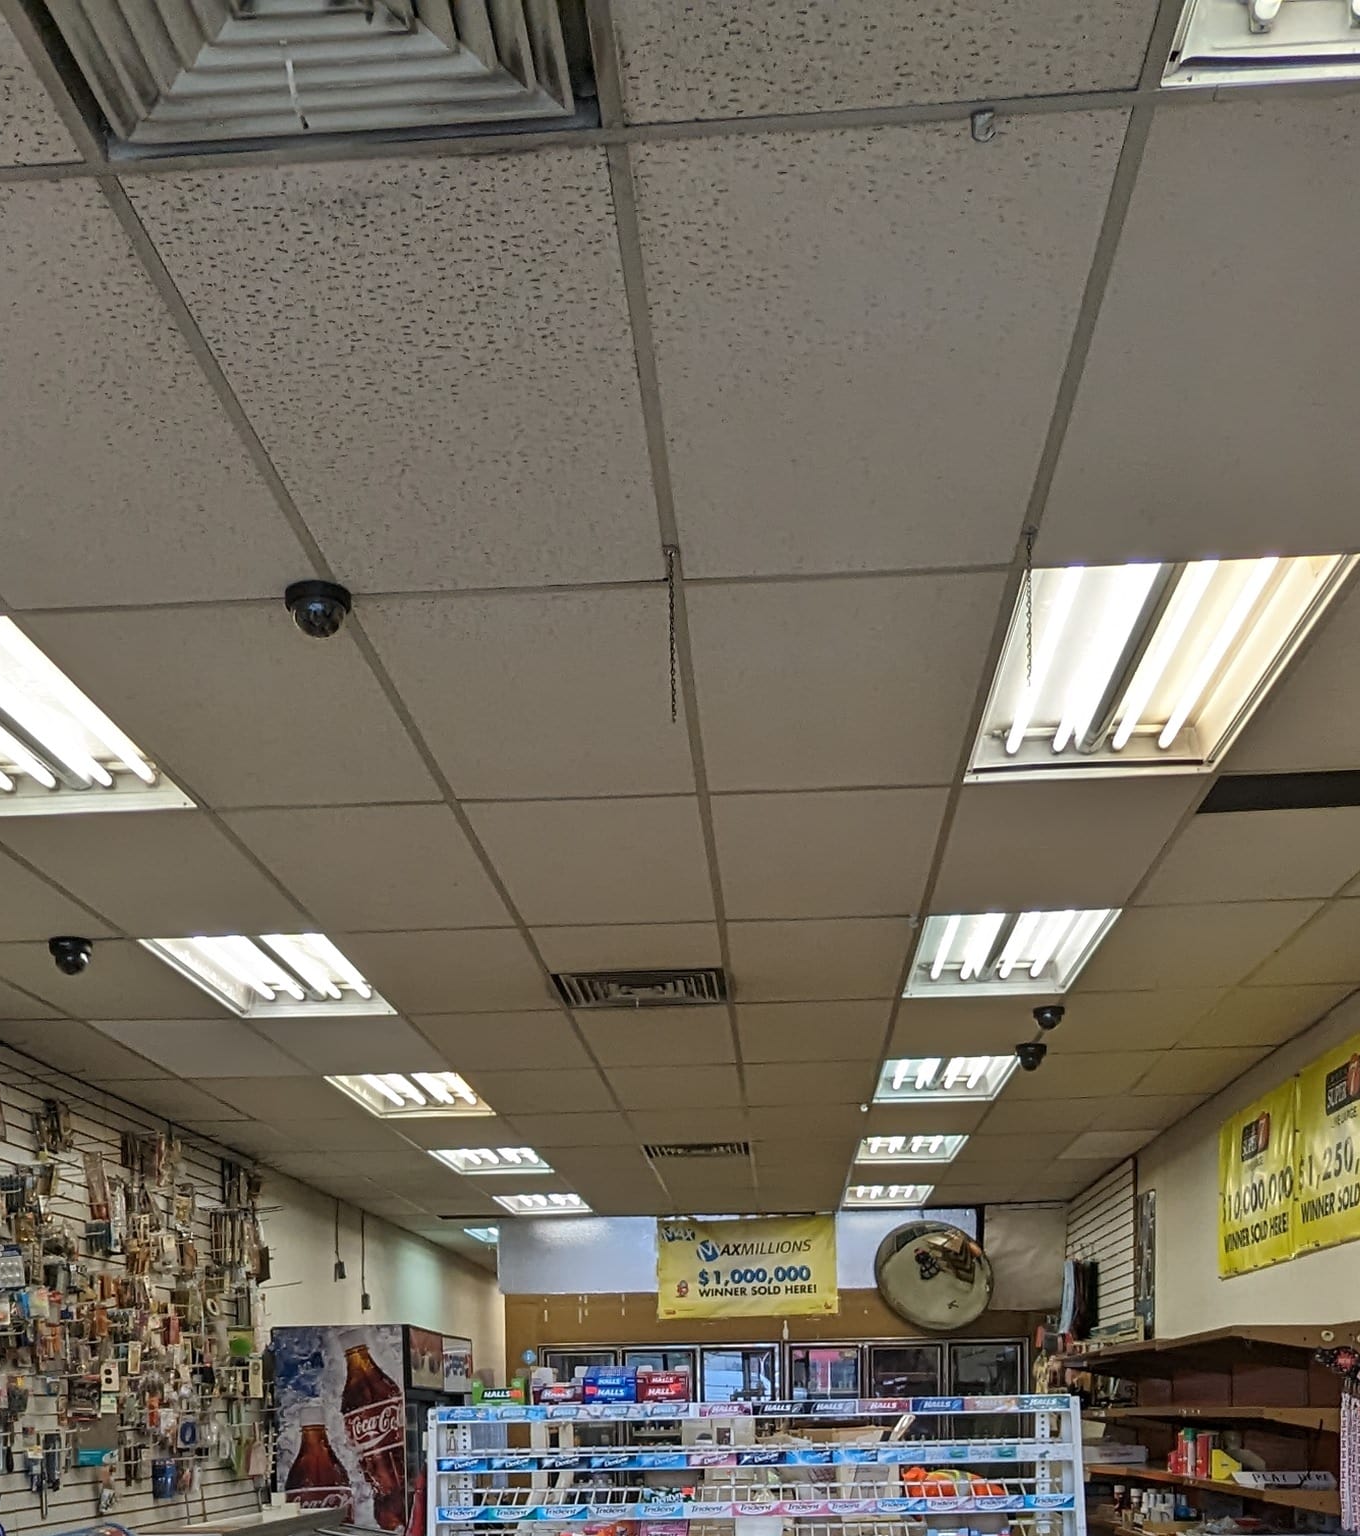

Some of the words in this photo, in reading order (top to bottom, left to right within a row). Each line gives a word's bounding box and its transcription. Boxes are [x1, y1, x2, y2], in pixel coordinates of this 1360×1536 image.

[1301, 1198, 1335, 1224] WINNER
[1337, 1185, 1360, 1212] SOLD
[661, 1226, 695, 1242] MAX
[1223, 1223, 1249, 1253] WINNER
[1250, 1218, 1269, 1243] SOLD
[1269, 1212, 1289, 1237] HERE!
[696, 1239, 811, 1262] MAXMILLIONS
[698, 1265, 811, 1287] $1,000,000
[698, 1286, 748, 1297] WINNER
[751, 1285, 781, 1295] SOLD
[785, 1283, 817, 1294] HERE!
[483, 1389, 511, 1398] HALLS
[598, 1387, 624, 1396] HALLS
[648, 1387, 676, 1396] HALLS
[712, 1405, 739, 1413] HALLS
[764, 1403, 790, 1412] HALLS
[816, 1402, 843, 1410] HALLS
[870, 1401, 897, 1409] HALLS
[924, 1401, 951, 1409] HALLS
[604, 1455, 629, 1467] Dentyne
[704, 1454, 728, 1464] Dentyne
[754, 1451, 779, 1462] Dentyne
[454, 1459, 478, 1469] Dentyne
[504, 1458, 529, 1468] Dentyne
[554, 1456, 579, 1467] Dentyne
[1252, 1472, 1287, 1483] PLAY
[979, 1498, 1007, 1506] Trident
[1033, 1496, 1064, 1504] Trident
[644, 1505, 675, 1513] Trident
[692, 1504, 722, 1512] Trident
[740, 1503, 771, 1511] Trident
[788, 1502, 819, 1510] Trident
[832, 1502, 860, 1510] Trident
[880, 1501, 910, 1509] Trident
[446, 1508, 477, 1516] Trident
[496, 1508, 527, 1516] Trident
[545, 1507, 576, 1515] Trident
[595, 1506, 626, 1514] Trident
